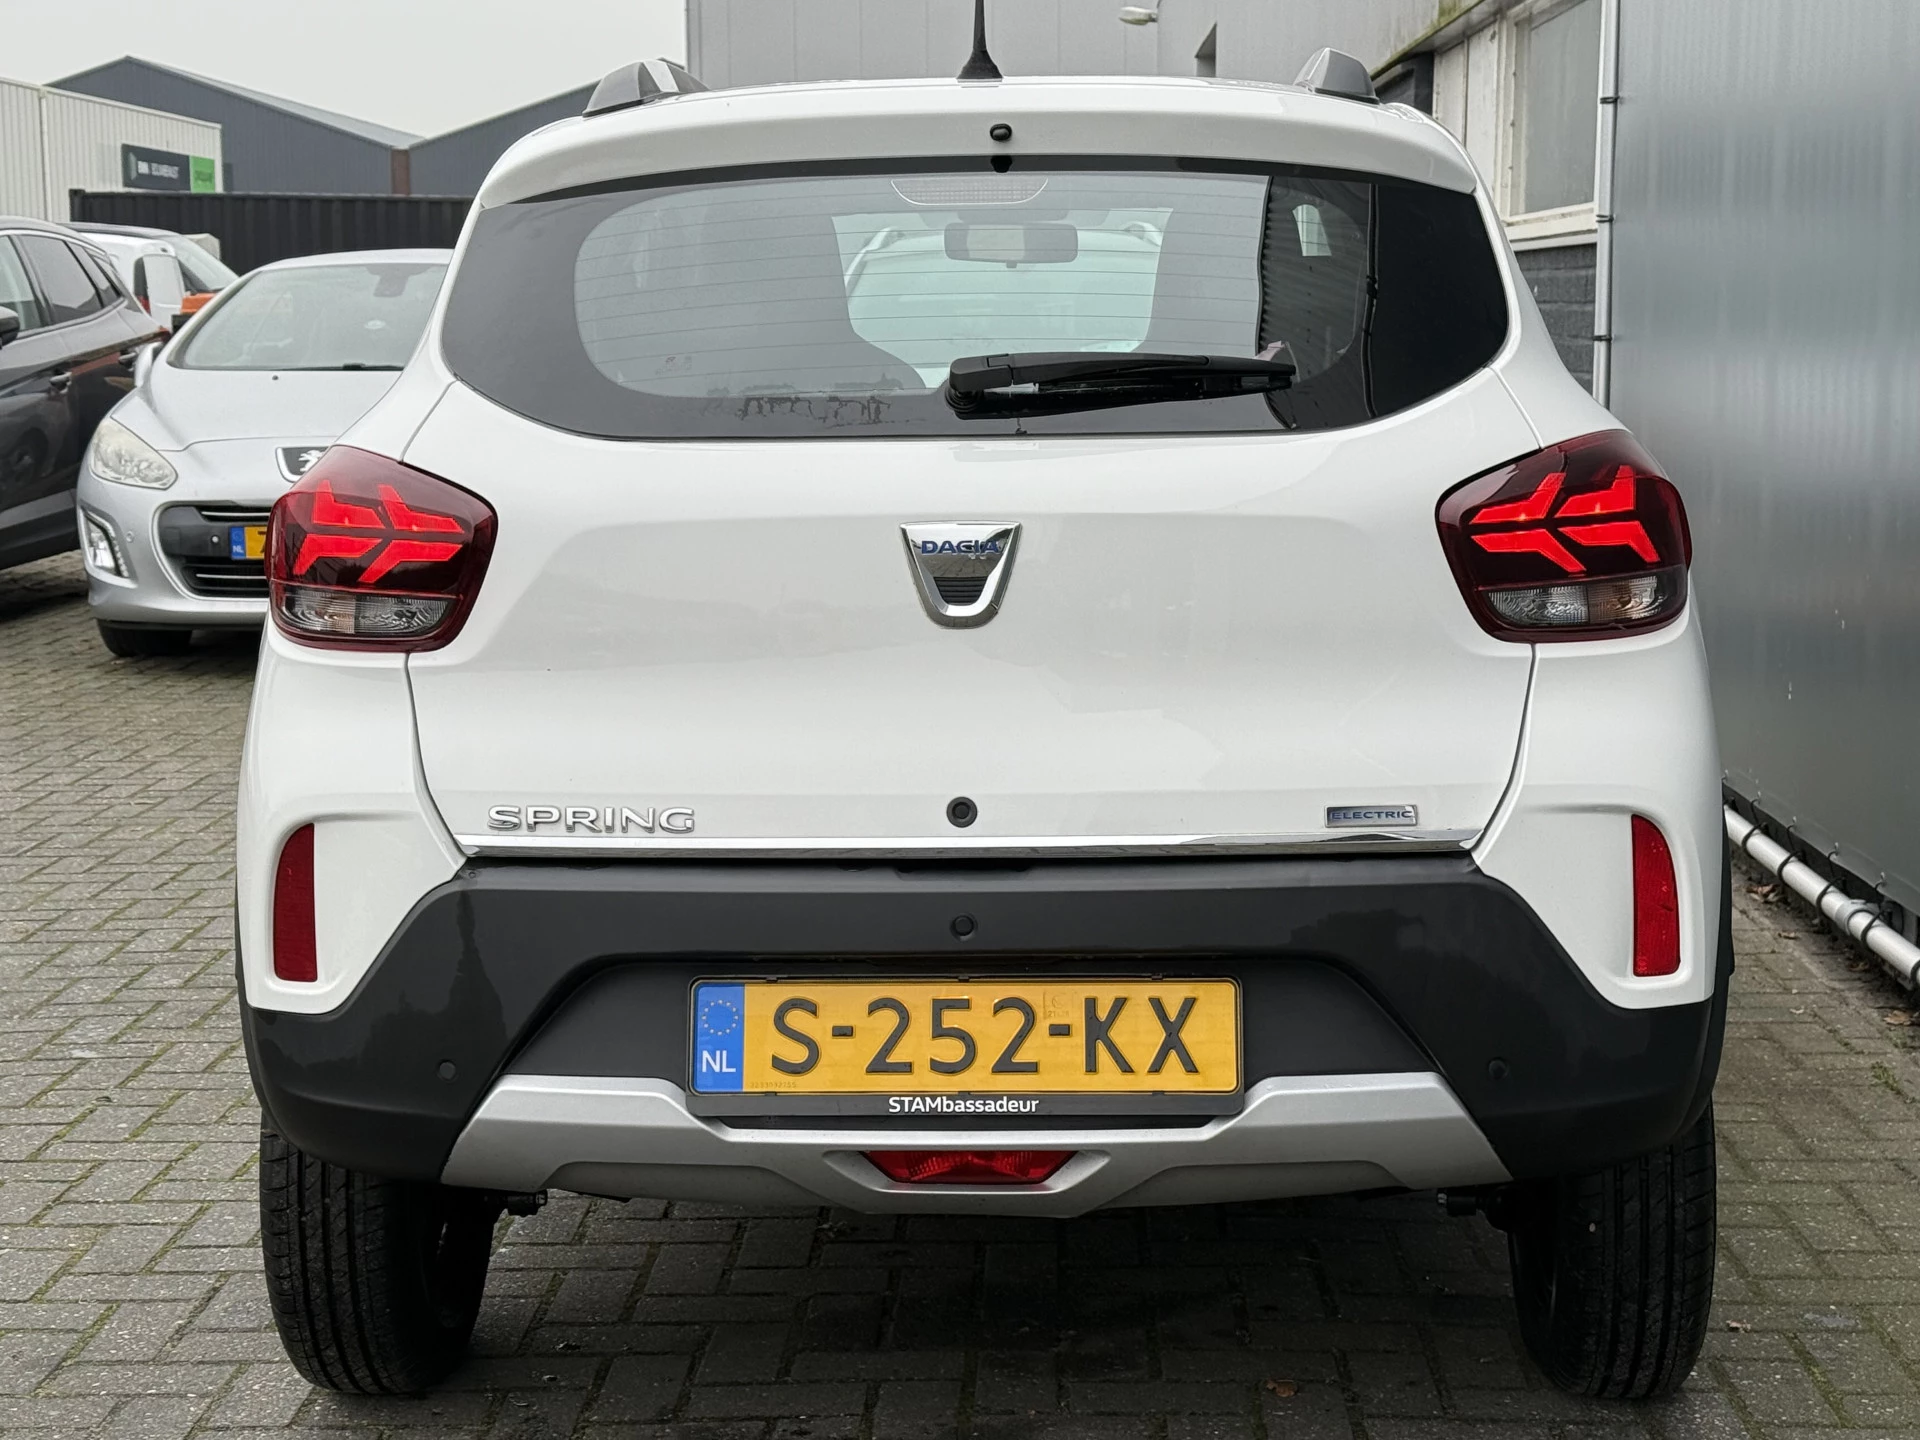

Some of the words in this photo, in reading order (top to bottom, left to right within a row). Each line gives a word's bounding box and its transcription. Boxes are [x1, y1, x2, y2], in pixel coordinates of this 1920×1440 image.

[232, 545, 245, 553] NL
[921, 540, 999, 554] DACIA
[487, 805, 695, 834] SPRING
[1331, 811, 1413, 820] ELECTRIC
[771, 996, 1198, 1075] S-252-KX
[702, 1050, 736, 1072] NL
[889, 1097, 1039, 1113] STAMbassadeur
